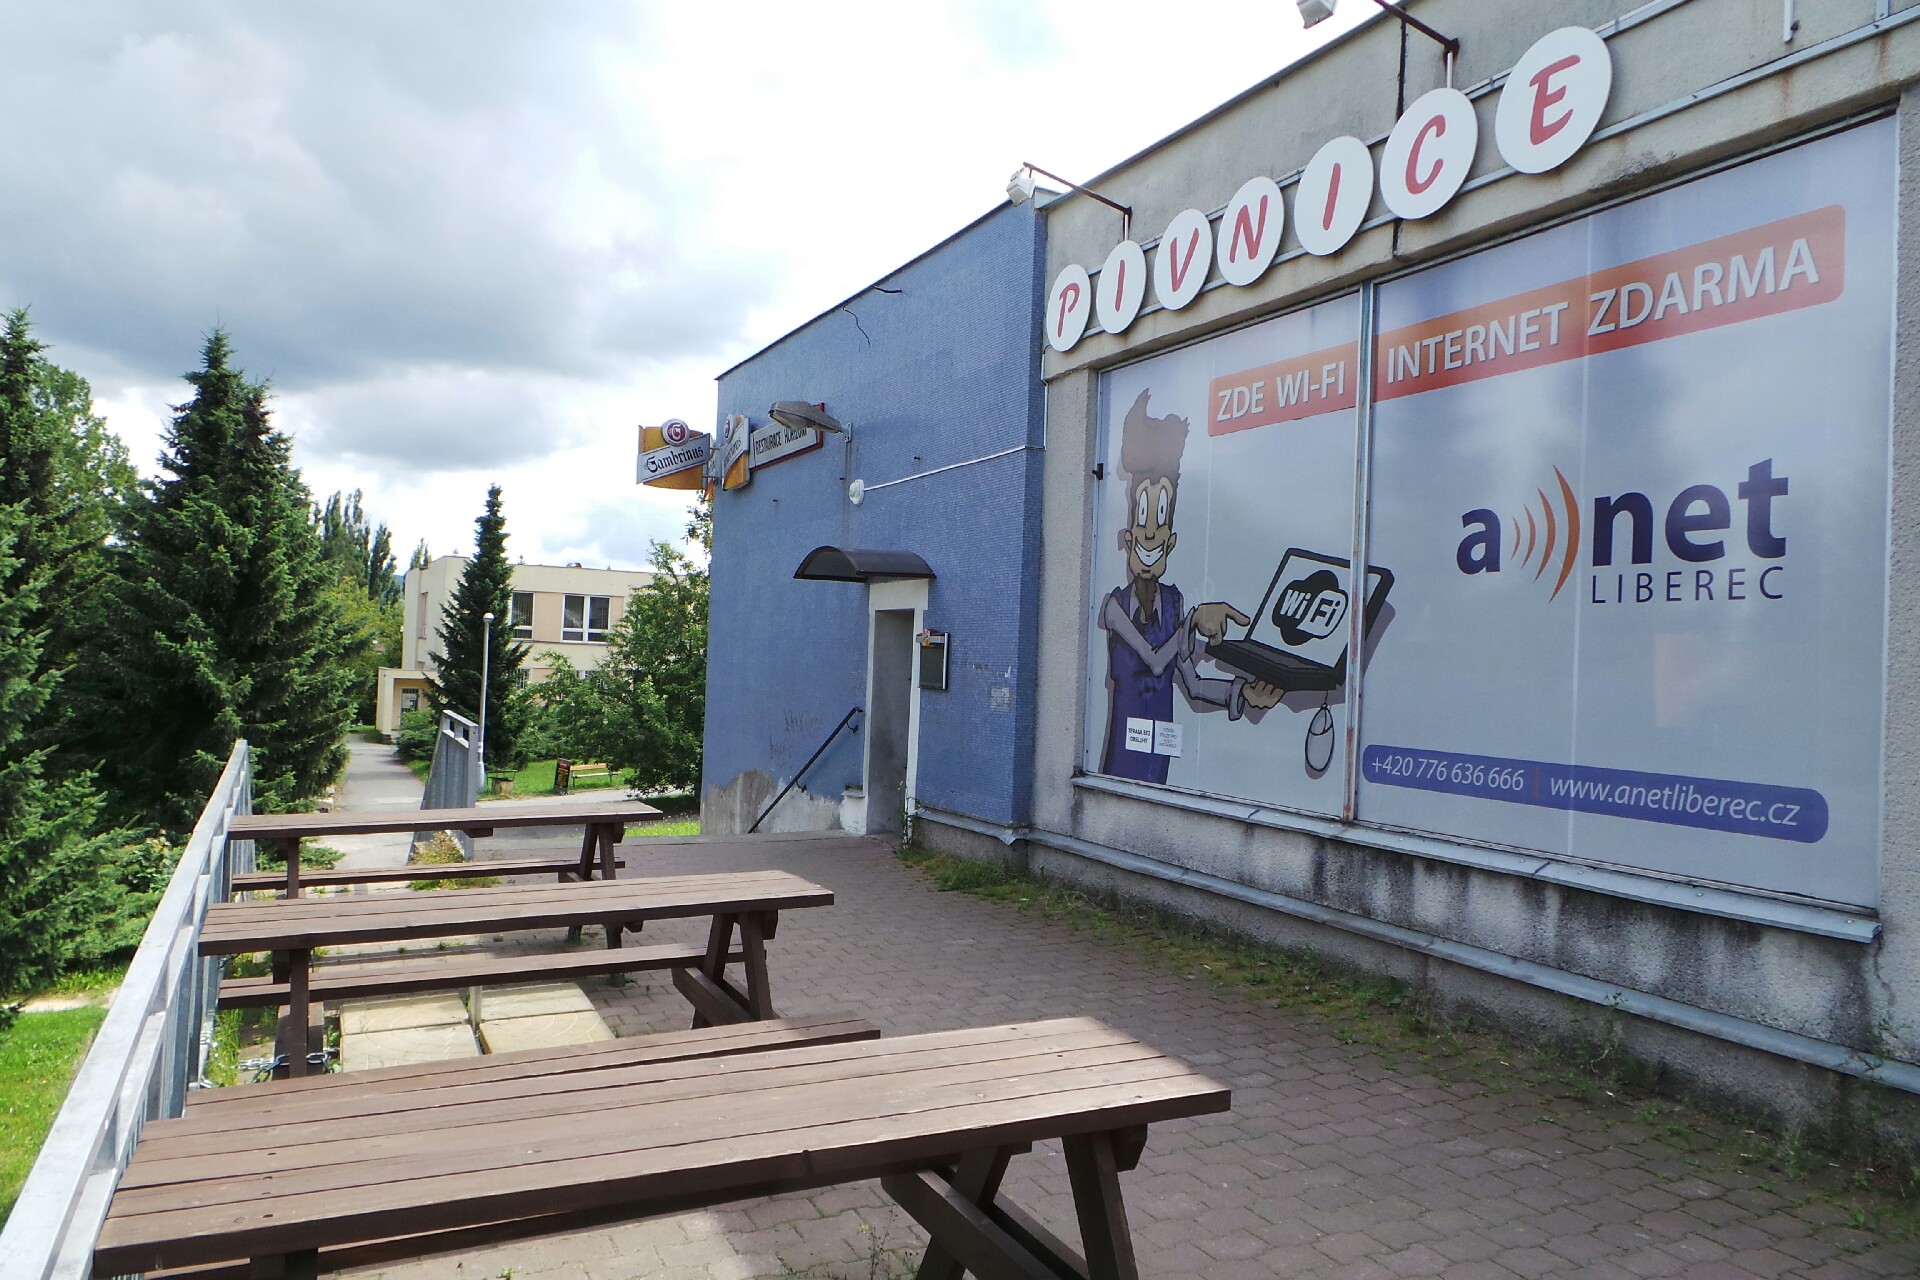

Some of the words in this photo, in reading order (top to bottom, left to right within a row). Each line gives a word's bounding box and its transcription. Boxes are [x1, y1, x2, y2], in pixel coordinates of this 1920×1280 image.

[1057, 54, 1581, 338] PIVNICE
[1216, 381, 1265, 422] ZDE
[1276, 361, 1346, 408] WI-FI
[1387, 301, 1569, 384] INTERNET
[1587, 238, 1820, 337] ZDARMA
[645, 447, 704, 473] Gambrinus
[1591, 566, 1785, 604] LIBEREC
[1371, 755, 1413, 777] +420
[1416, 758, 1448, 782] 776
[1450, 762, 1484, 787] 636
[1487, 767, 1525, 792] 666
[1549, 774, 1801, 827] www.anetliberec.cz
